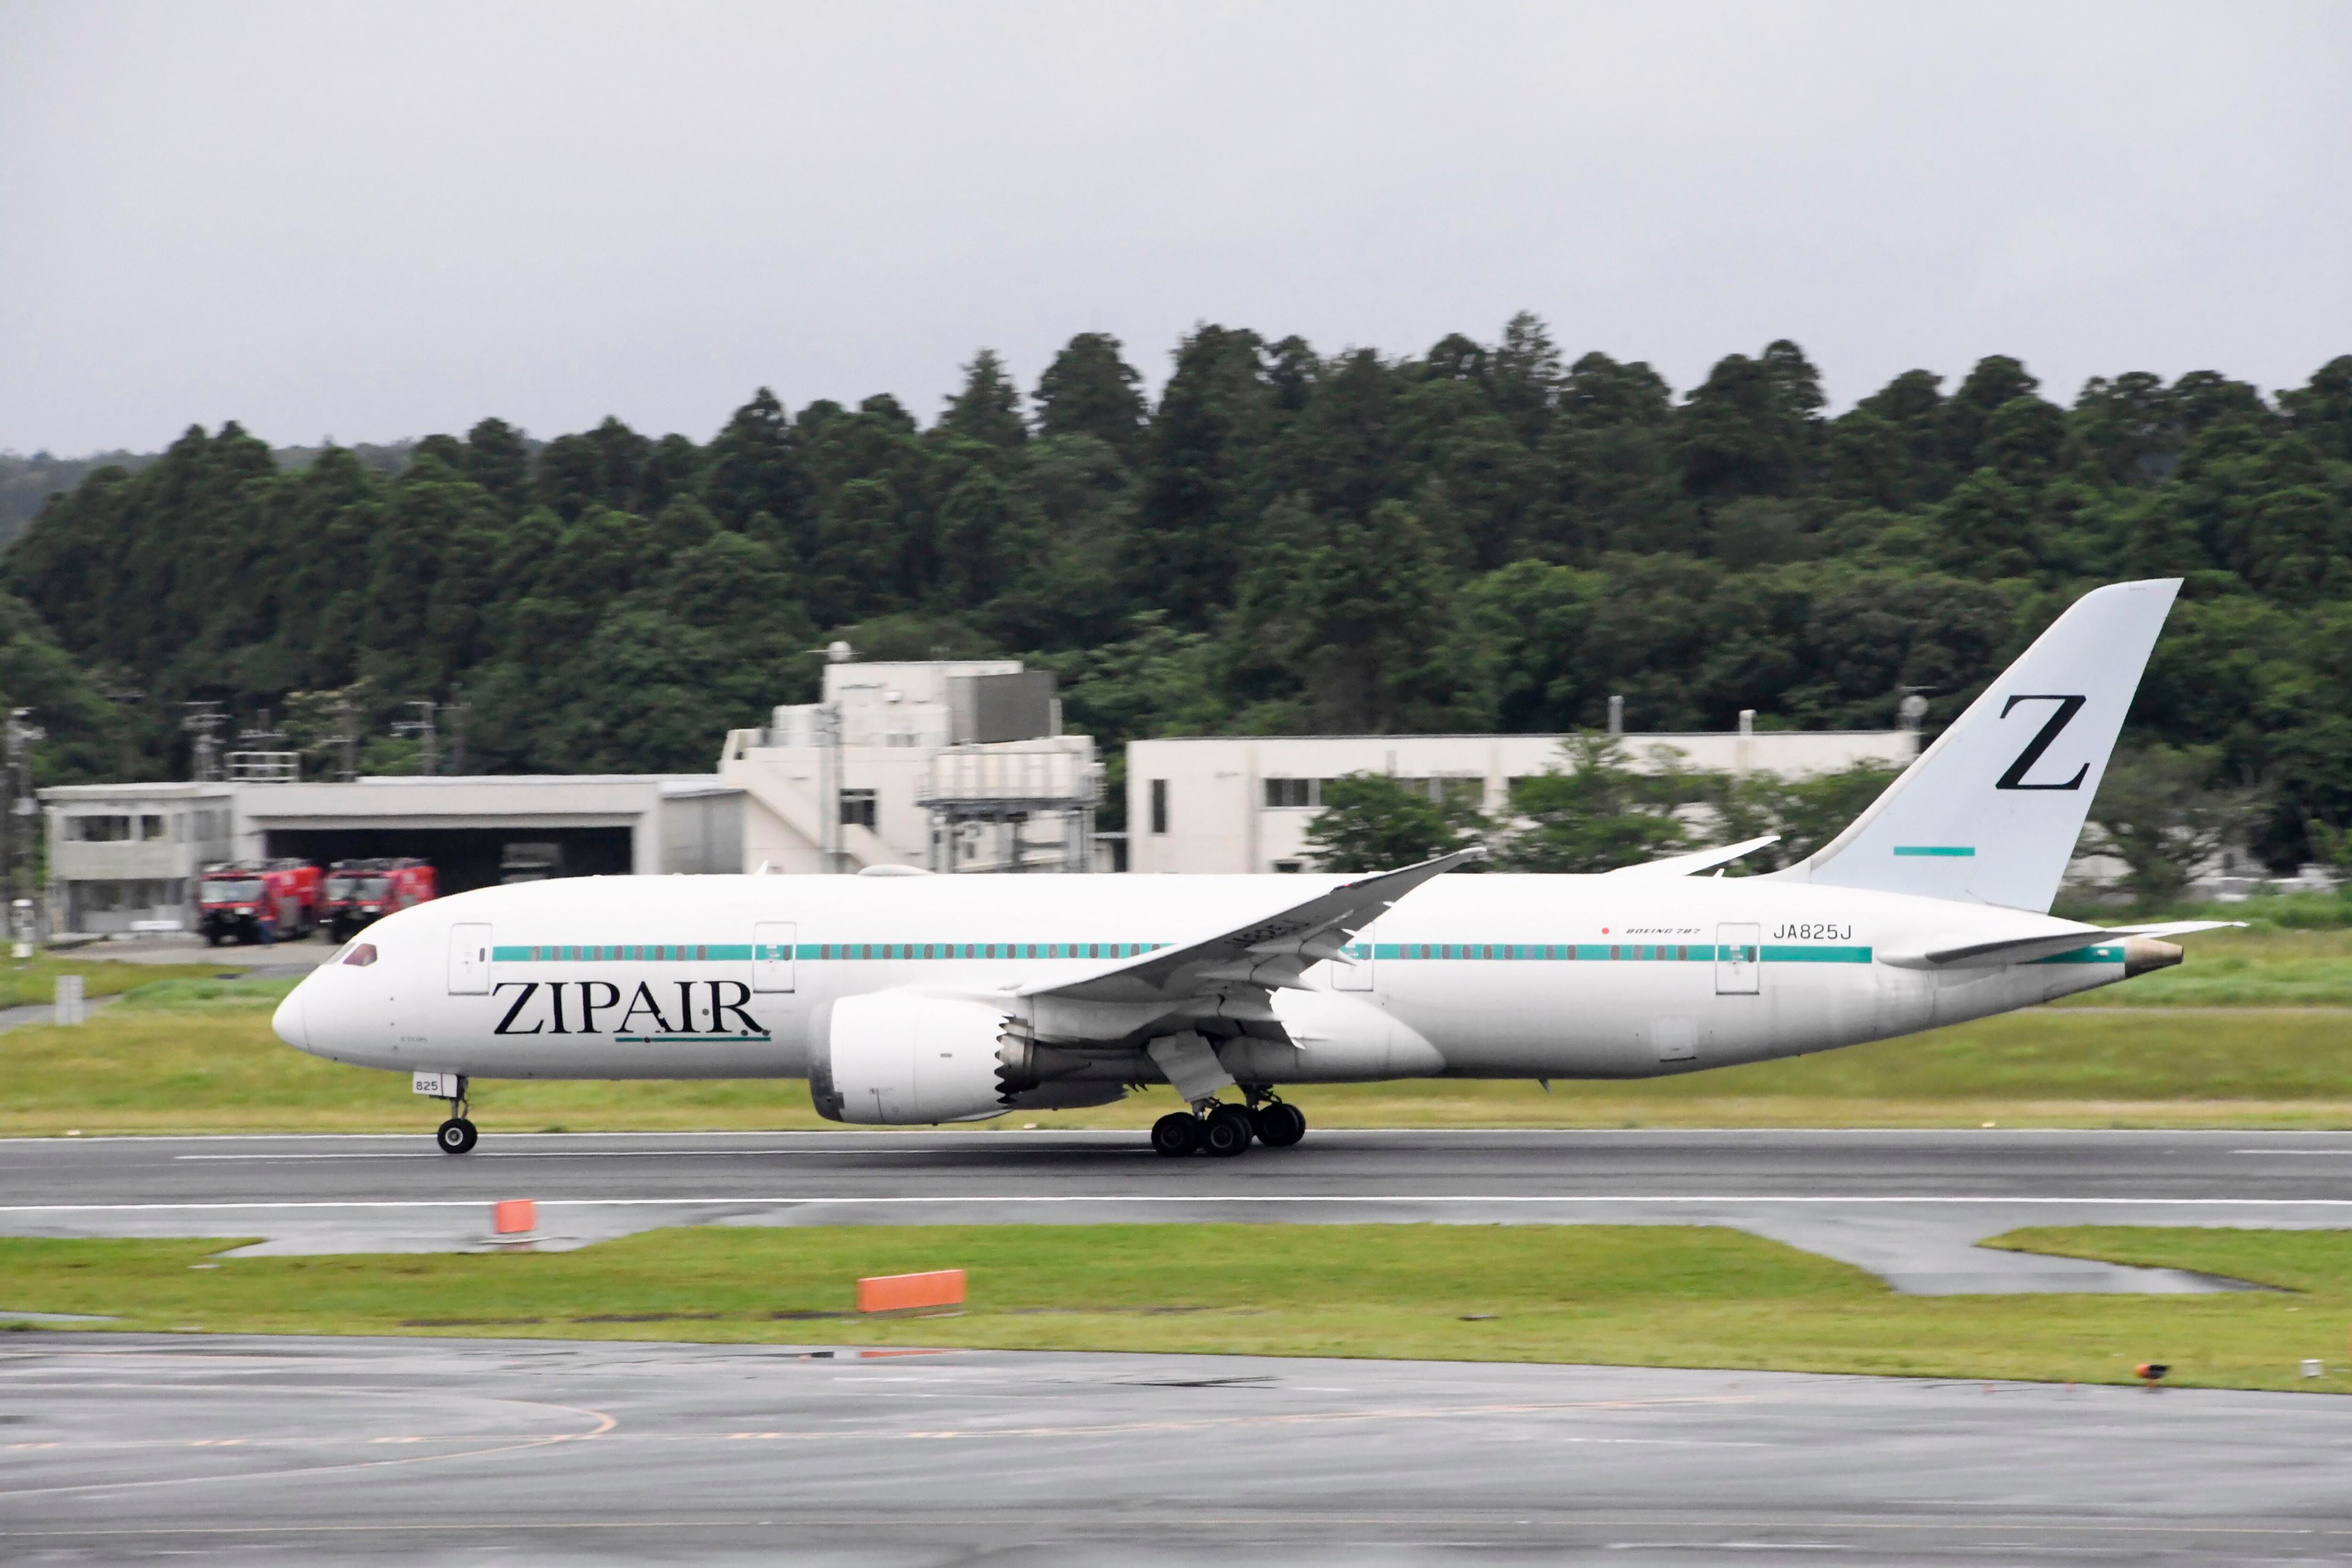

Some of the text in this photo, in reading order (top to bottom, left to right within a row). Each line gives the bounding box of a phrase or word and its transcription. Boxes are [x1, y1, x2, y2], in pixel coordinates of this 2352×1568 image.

[1995, 695, 2090, 790] Z
[1773, 924, 1851, 939] JA825J
[492, 981, 771, 1035] ZIPAIR
[416, 1081, 438, 1090] 825
